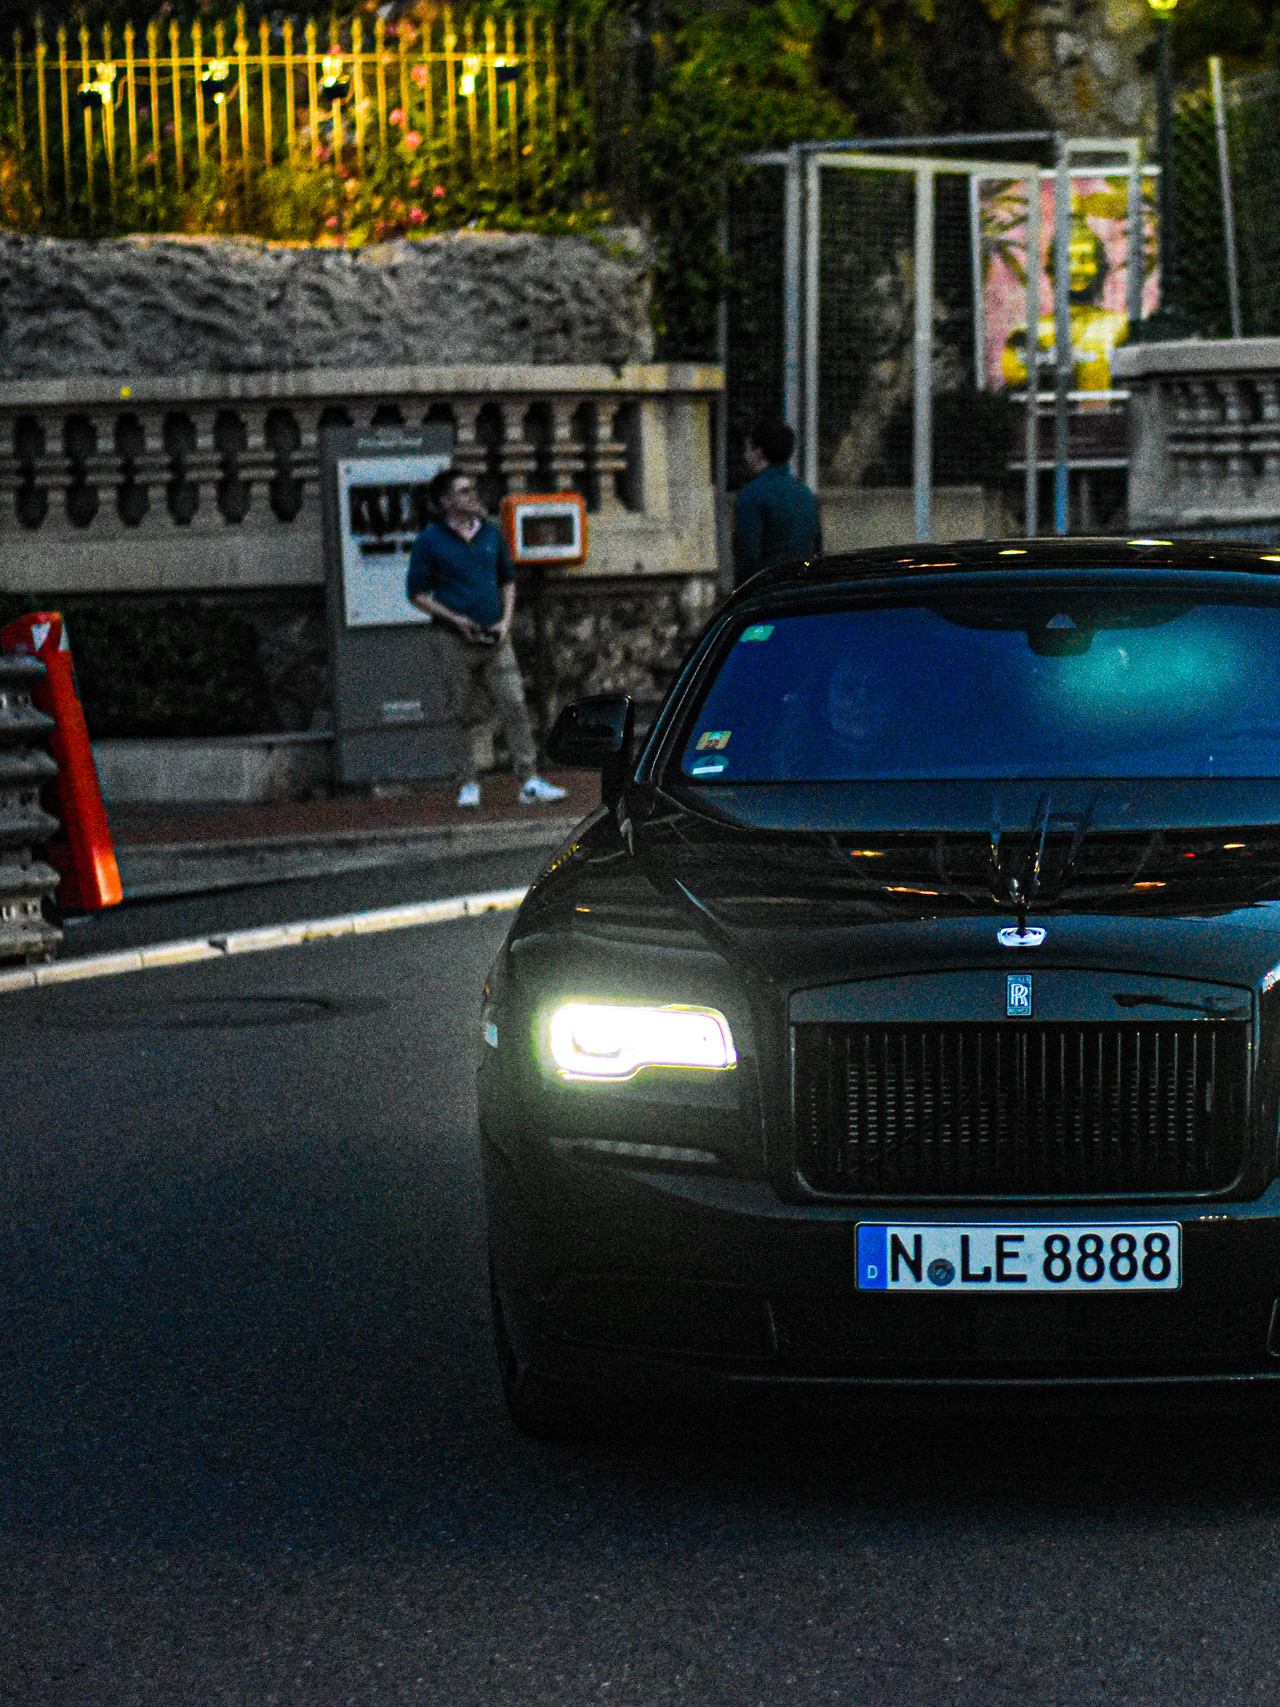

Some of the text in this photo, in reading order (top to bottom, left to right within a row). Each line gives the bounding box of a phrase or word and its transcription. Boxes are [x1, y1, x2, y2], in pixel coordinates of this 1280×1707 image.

[868, 1265, 878, 1279] D
[890, 1232, 1171, 1283] N LE 8888
